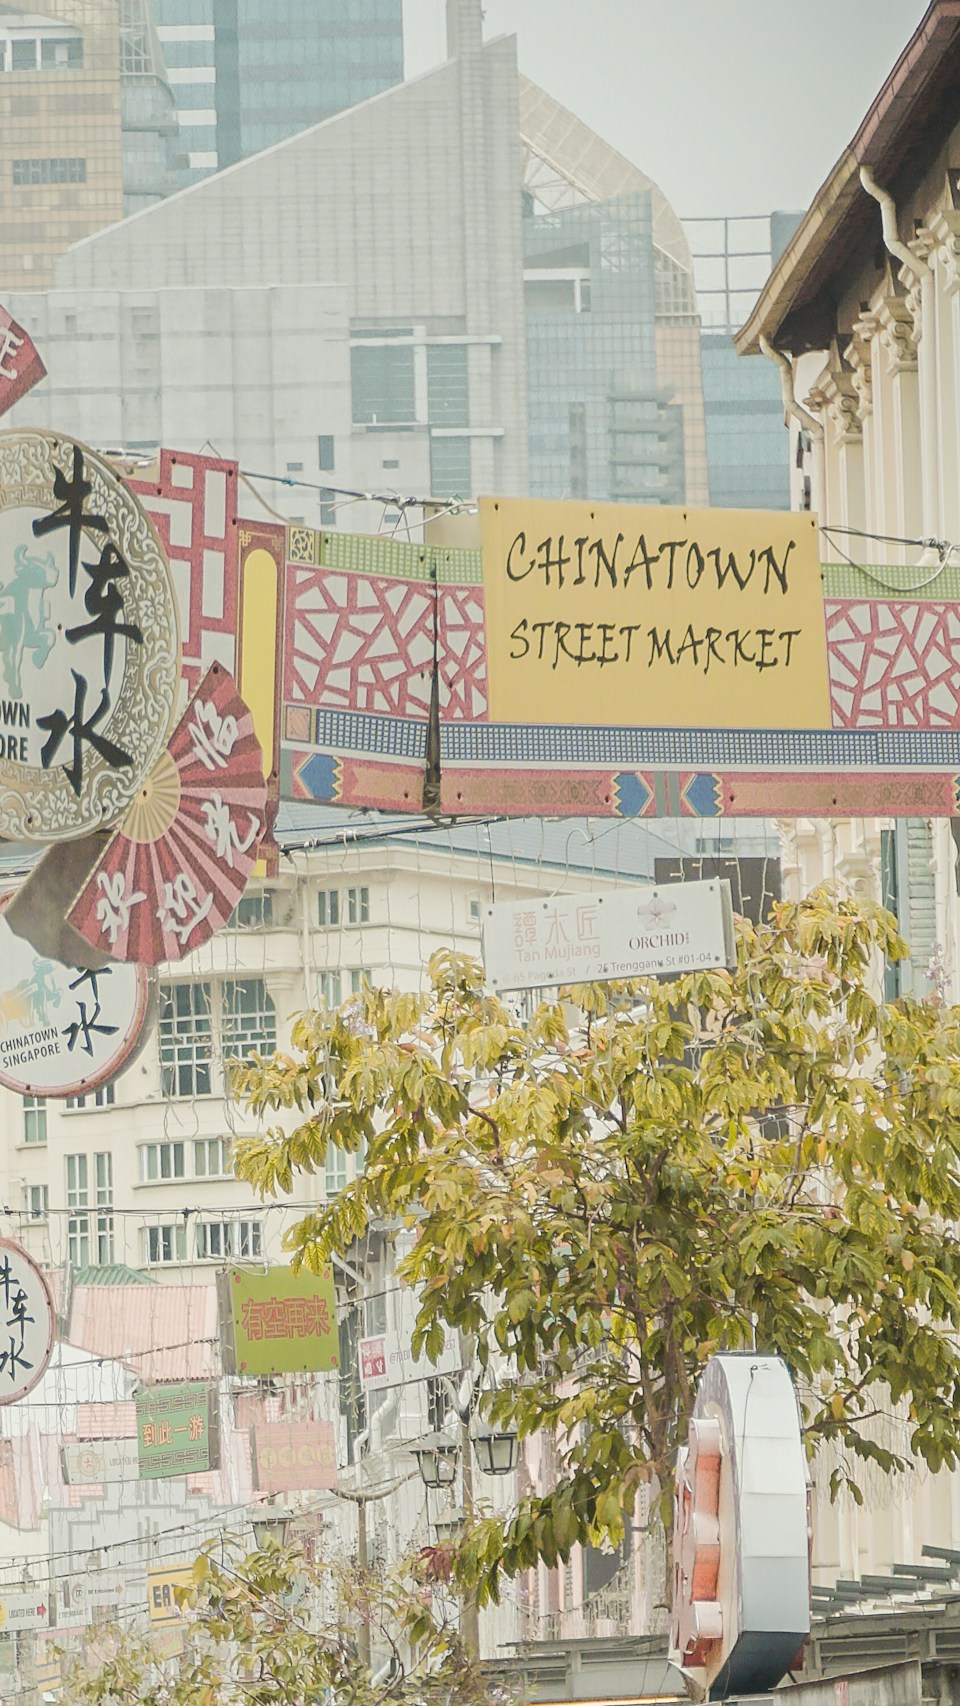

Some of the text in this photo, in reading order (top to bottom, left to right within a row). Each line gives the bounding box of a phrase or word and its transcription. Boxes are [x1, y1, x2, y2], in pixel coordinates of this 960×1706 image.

[506, 531, 796, 596] CHINATOWN
[32, 446, 143, 798] 牛车水
[510, 618, 802, 674] STREET MARKET
[515, 943, 601, 964] Tan Mujiang
[629, 932, 685, 950] ORCHID
[666, 956, 676, 966] St
[678, 952, 711, 965] #01-04
[0, 1026, 59, 1053] CHINATOWN
[2, 1042, 61, 1069] SINGAPORE
[241, 1295, 331, 1341] 有空再来
[143, 1414, 205, 1448] 到此一游
[9, 1607, 36, 1619] LOCATED HERE
